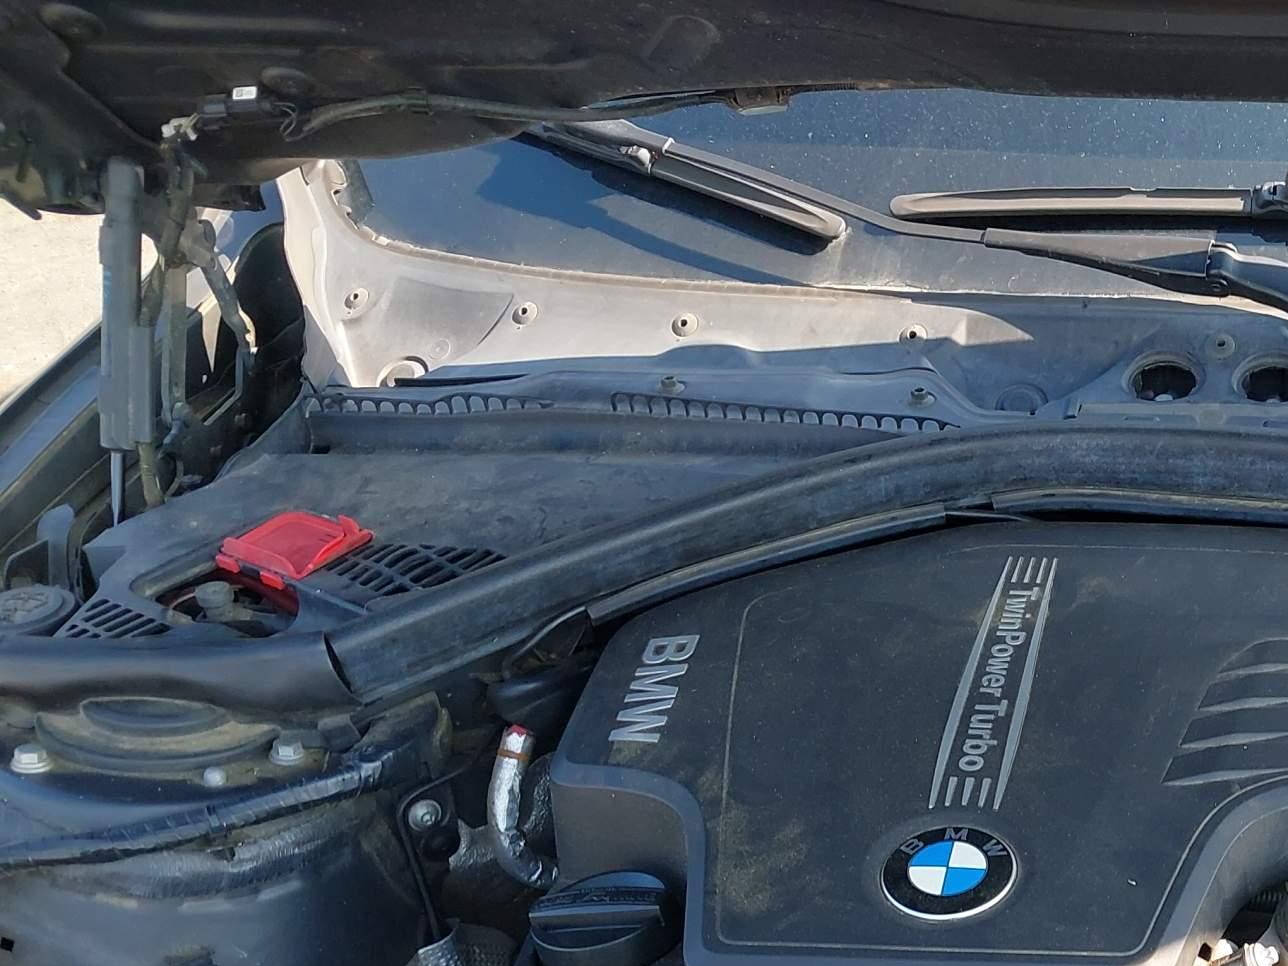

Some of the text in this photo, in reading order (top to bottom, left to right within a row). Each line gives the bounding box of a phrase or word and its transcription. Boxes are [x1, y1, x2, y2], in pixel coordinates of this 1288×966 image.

[608, 634, 701, 743] BMW
[957, 586, 1041, 772] TwinPower Turbo
[900, 827, 1009, 856] BMW
